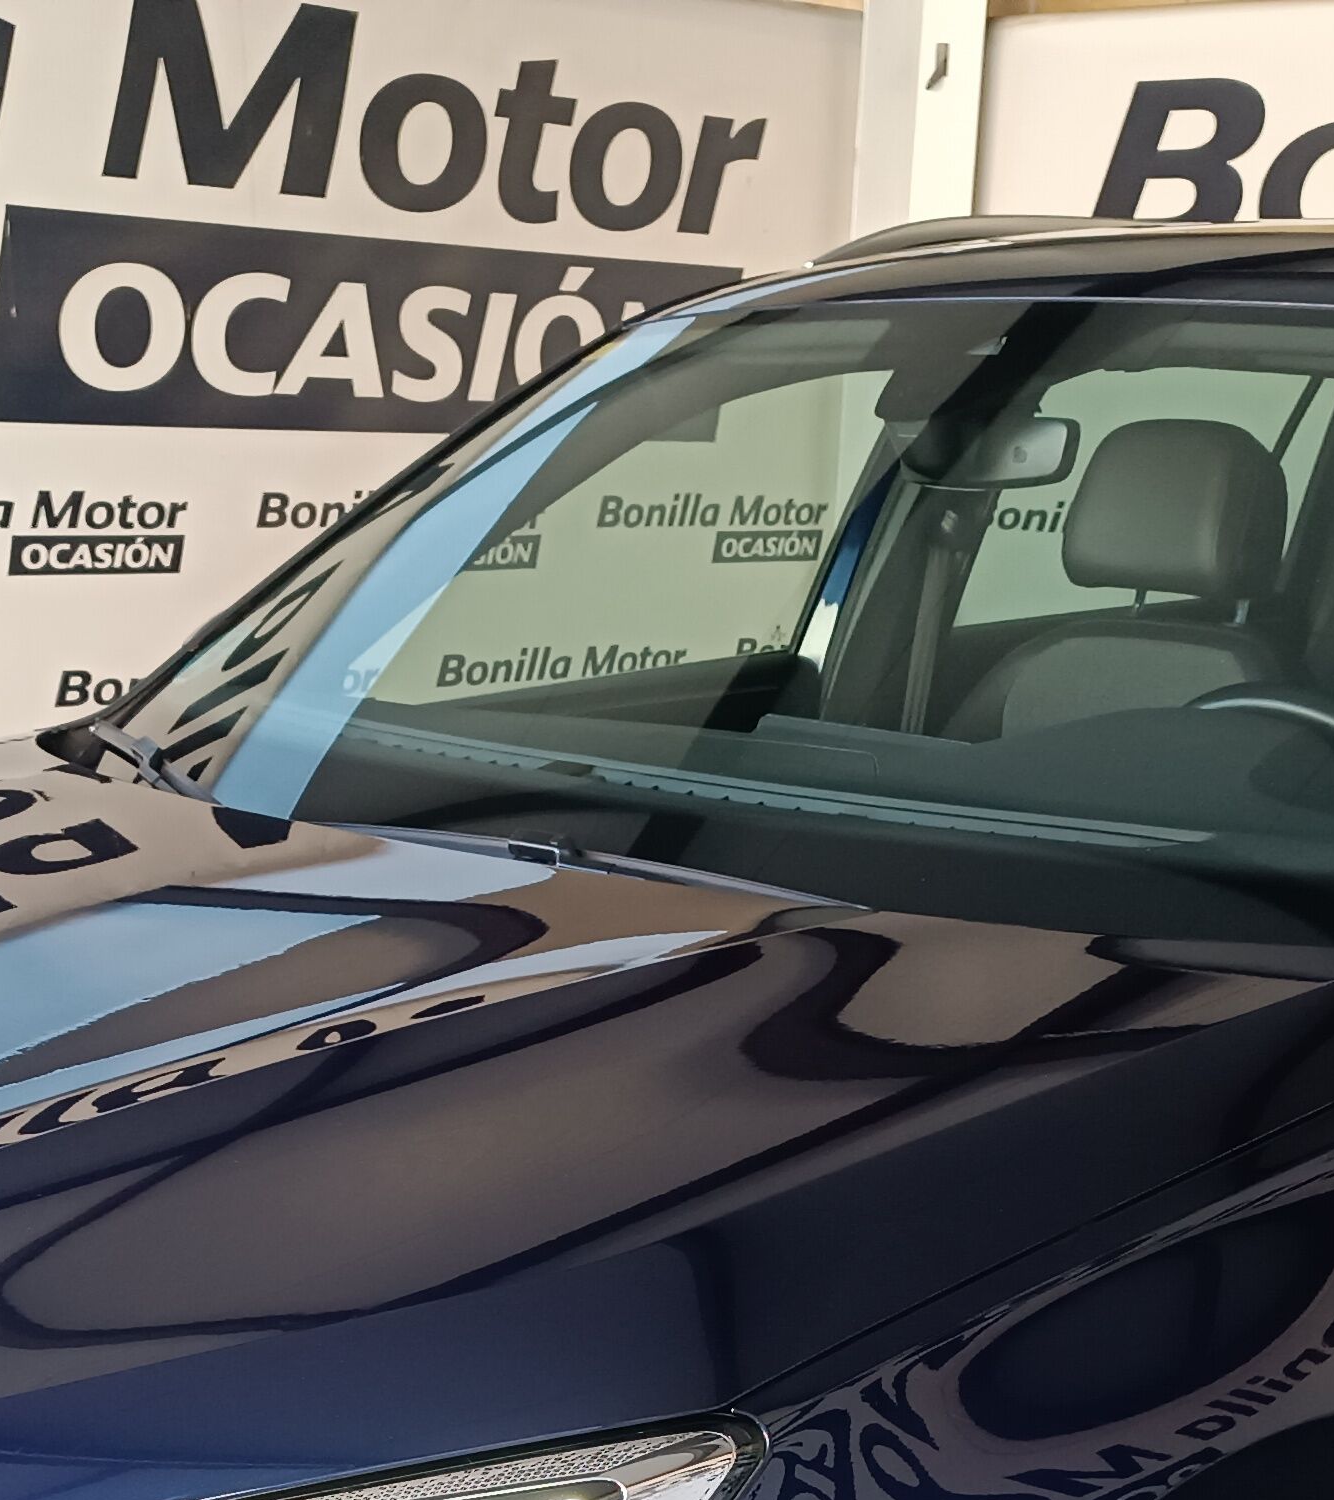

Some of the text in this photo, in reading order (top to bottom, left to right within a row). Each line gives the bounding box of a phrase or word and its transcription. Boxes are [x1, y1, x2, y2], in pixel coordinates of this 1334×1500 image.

[102, 0, 766, 235] Motor
[59, 263, 649, 403] OCASIÓ
[31, 490, 188, 529] Motor
[596, 493, 829, 528] Bonilla Motor
[20, 537, 175, 570] OCASIÓN
[720, 530, 818, 559] OCASIÓN
[436, 646, 573, 688] Bonilla
